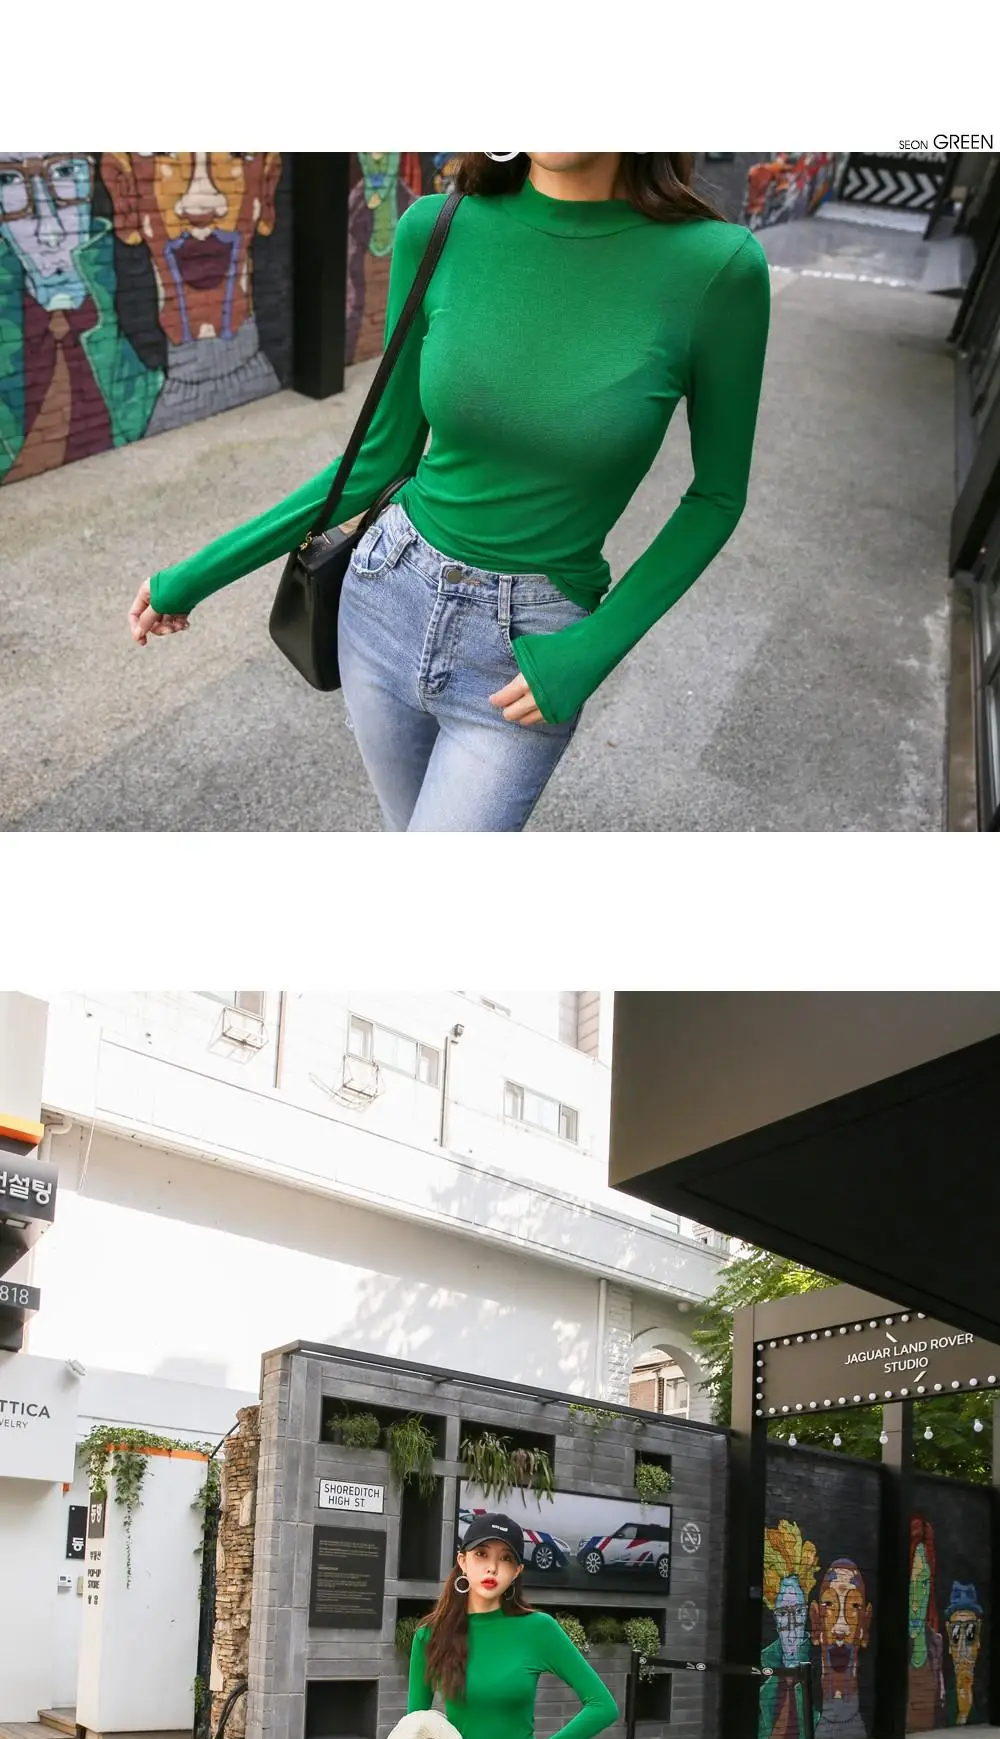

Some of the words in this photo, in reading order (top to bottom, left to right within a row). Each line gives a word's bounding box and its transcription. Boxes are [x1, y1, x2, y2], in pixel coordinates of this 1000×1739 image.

[844, 1347, 891, 1365] JAGUAR
[893, 1340, 928, 1357] LAND
[930, 1332, 974, 1350] ROVER
[883, 1357, 929, 1374] STUDIO
[324, 1483, 380, 1499] SHOREDITCH
[328, 1495, 350, 1507] HIGH
